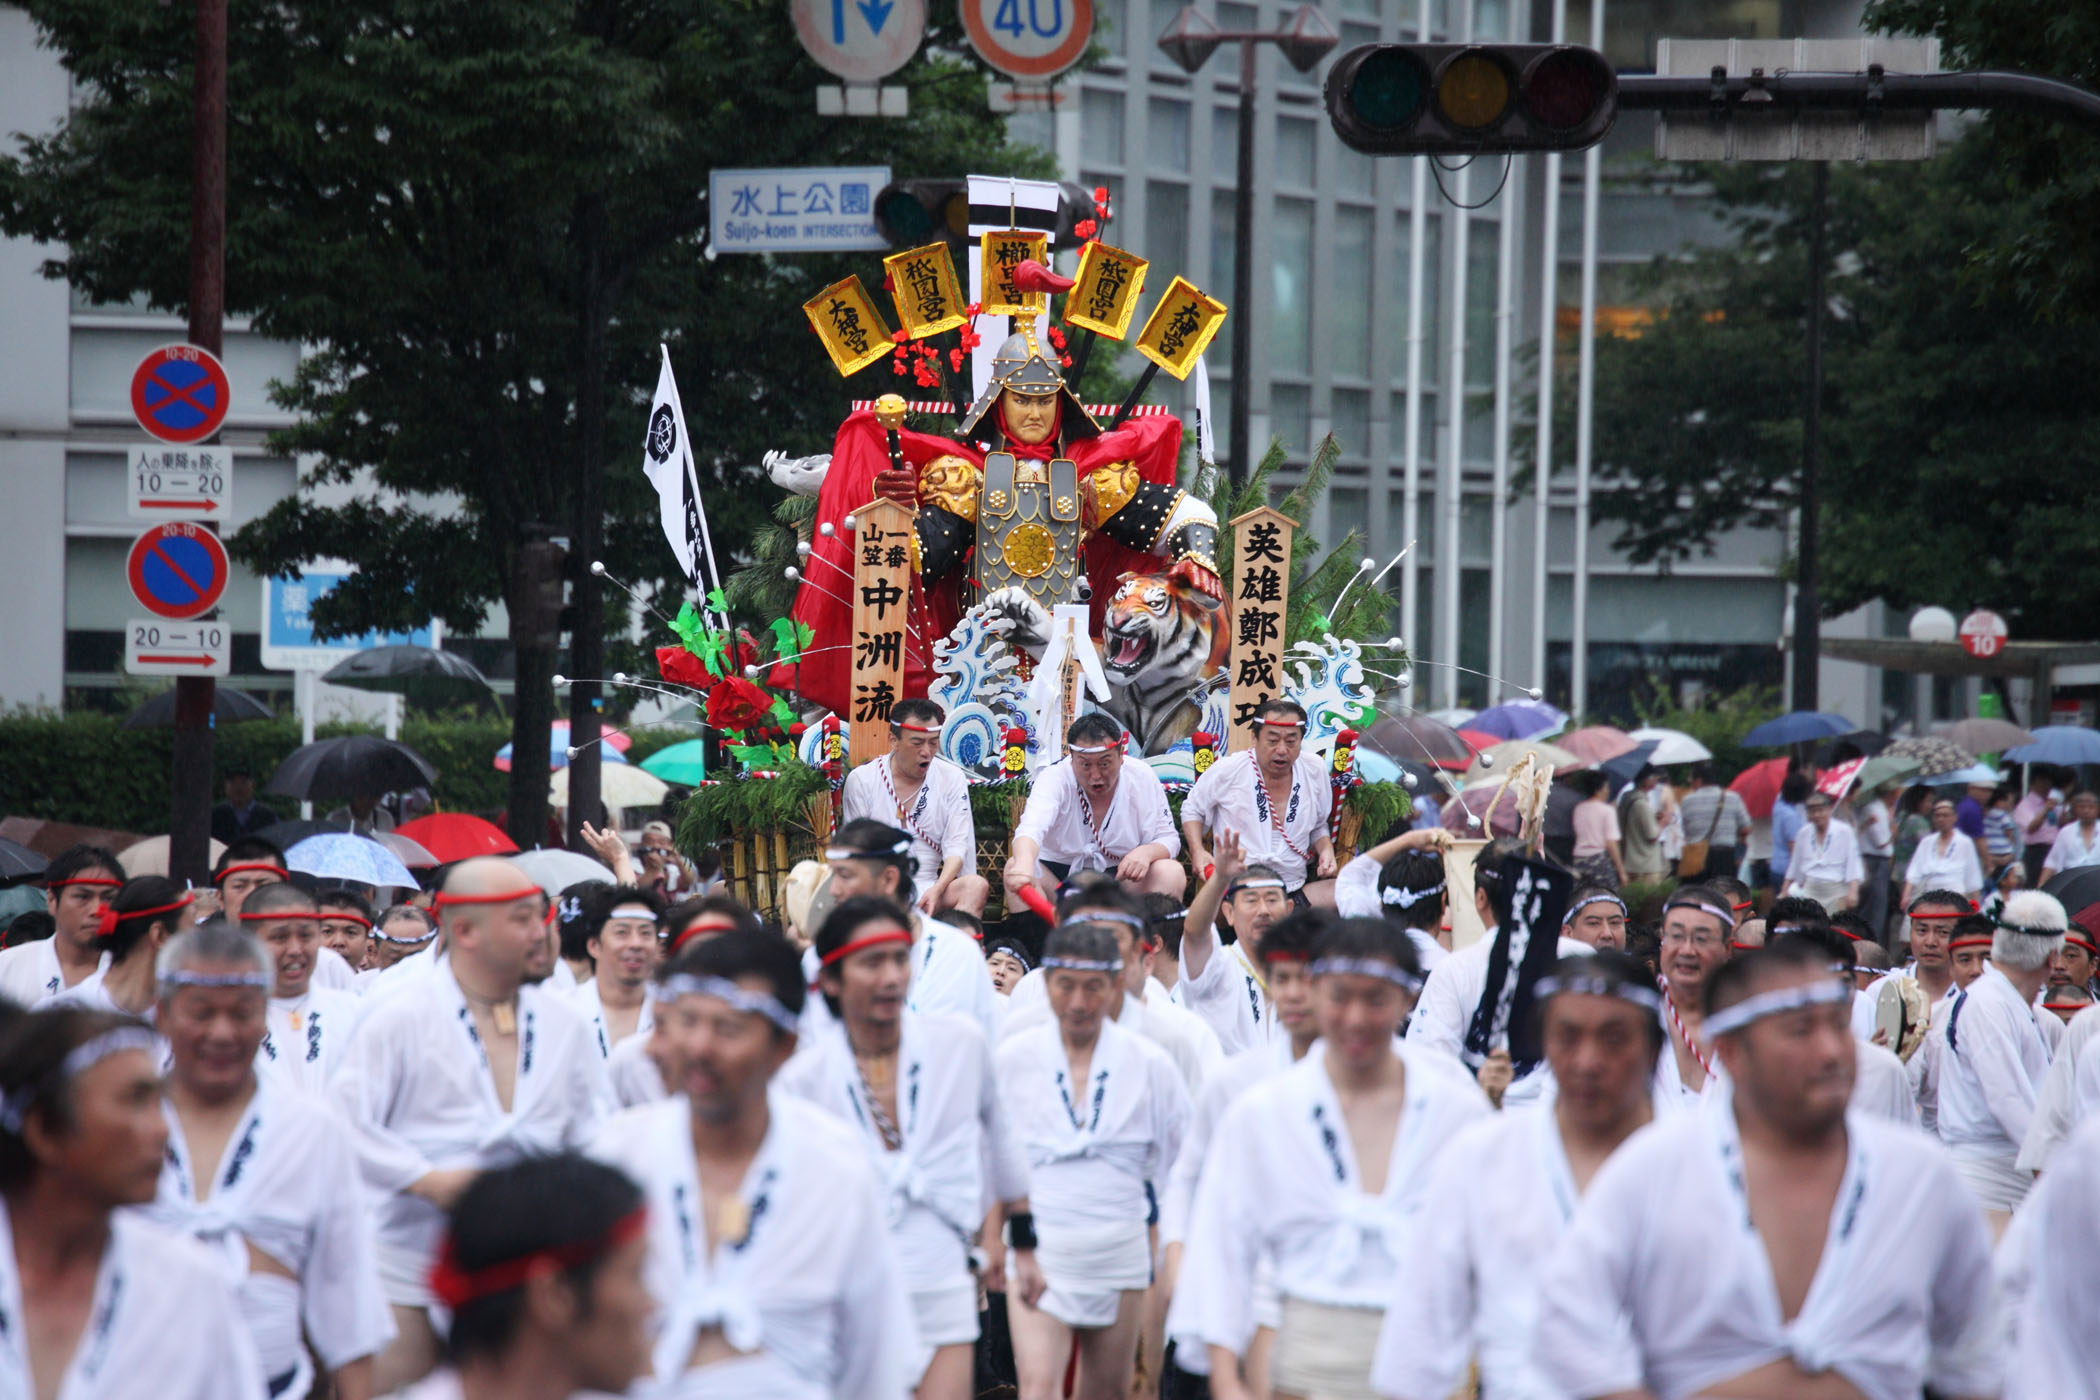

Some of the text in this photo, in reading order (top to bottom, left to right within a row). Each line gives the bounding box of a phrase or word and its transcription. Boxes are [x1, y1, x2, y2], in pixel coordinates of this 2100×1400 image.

[993, 0, 1063, 38] 40
[730, 181, 870, 217] 水上公園
[724, 221, 797, 244] Suijo-koen
[165, 345, 199, 362] 10-20
[136, 452, 223, 471] 人の乗降を除く
[161, 524, 197, 538] 20-10
[854, 577, 904, 724] 中洲流
[1971, 635, 1997, 656] 10
